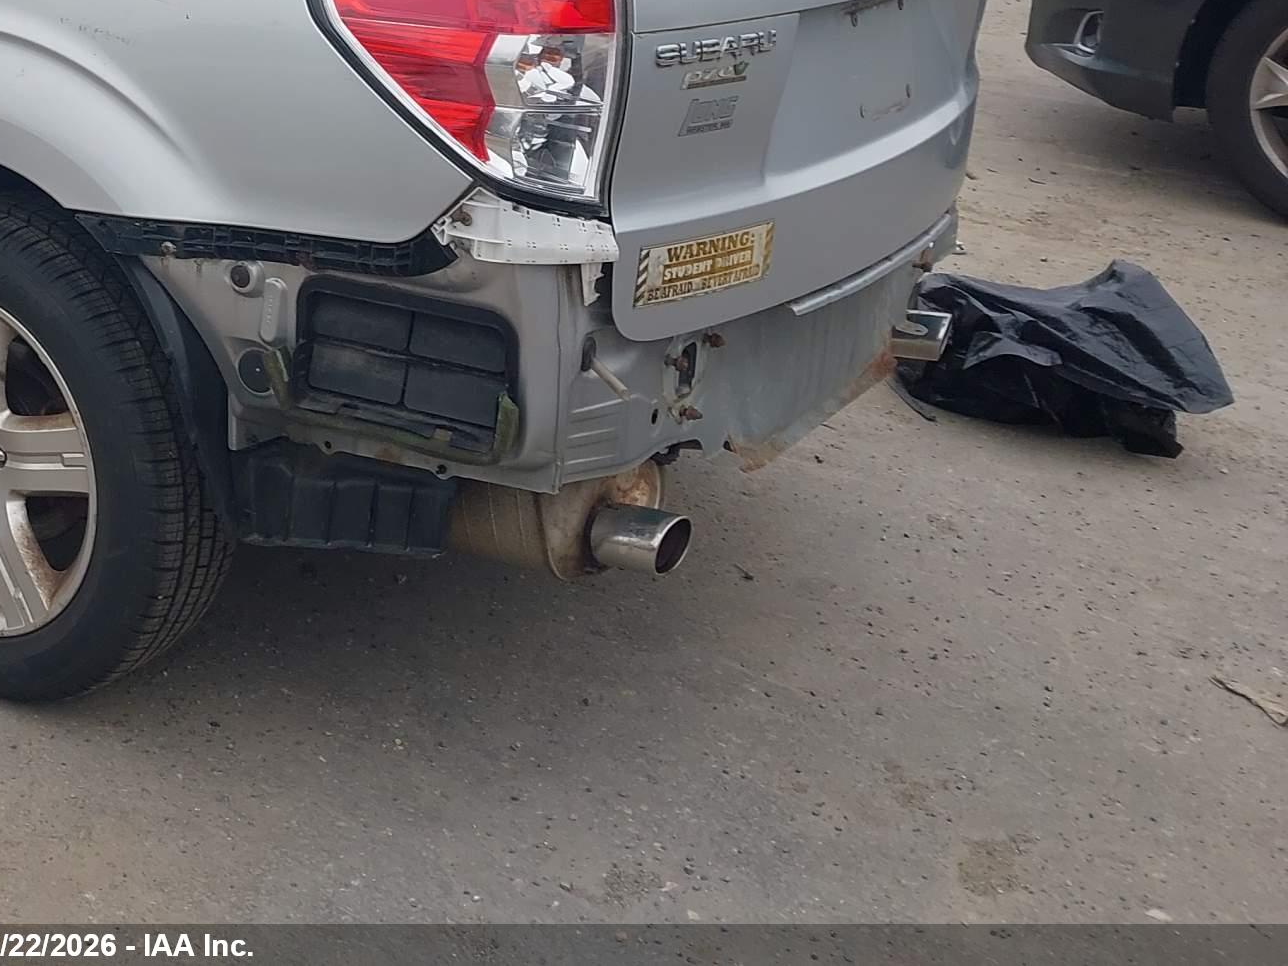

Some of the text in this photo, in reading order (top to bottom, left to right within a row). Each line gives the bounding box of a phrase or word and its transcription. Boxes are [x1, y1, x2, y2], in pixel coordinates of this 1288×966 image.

[656, 30, 777, 67] SUBARU
[668, 232, 755, 263] WARNING:
[663, 250, 753, 281] STUDENT DRIVER
[647, 287, 660, 301] BE
[701, 276, 713, 290] BE
[732, 265, 760, 282] AFRAID
